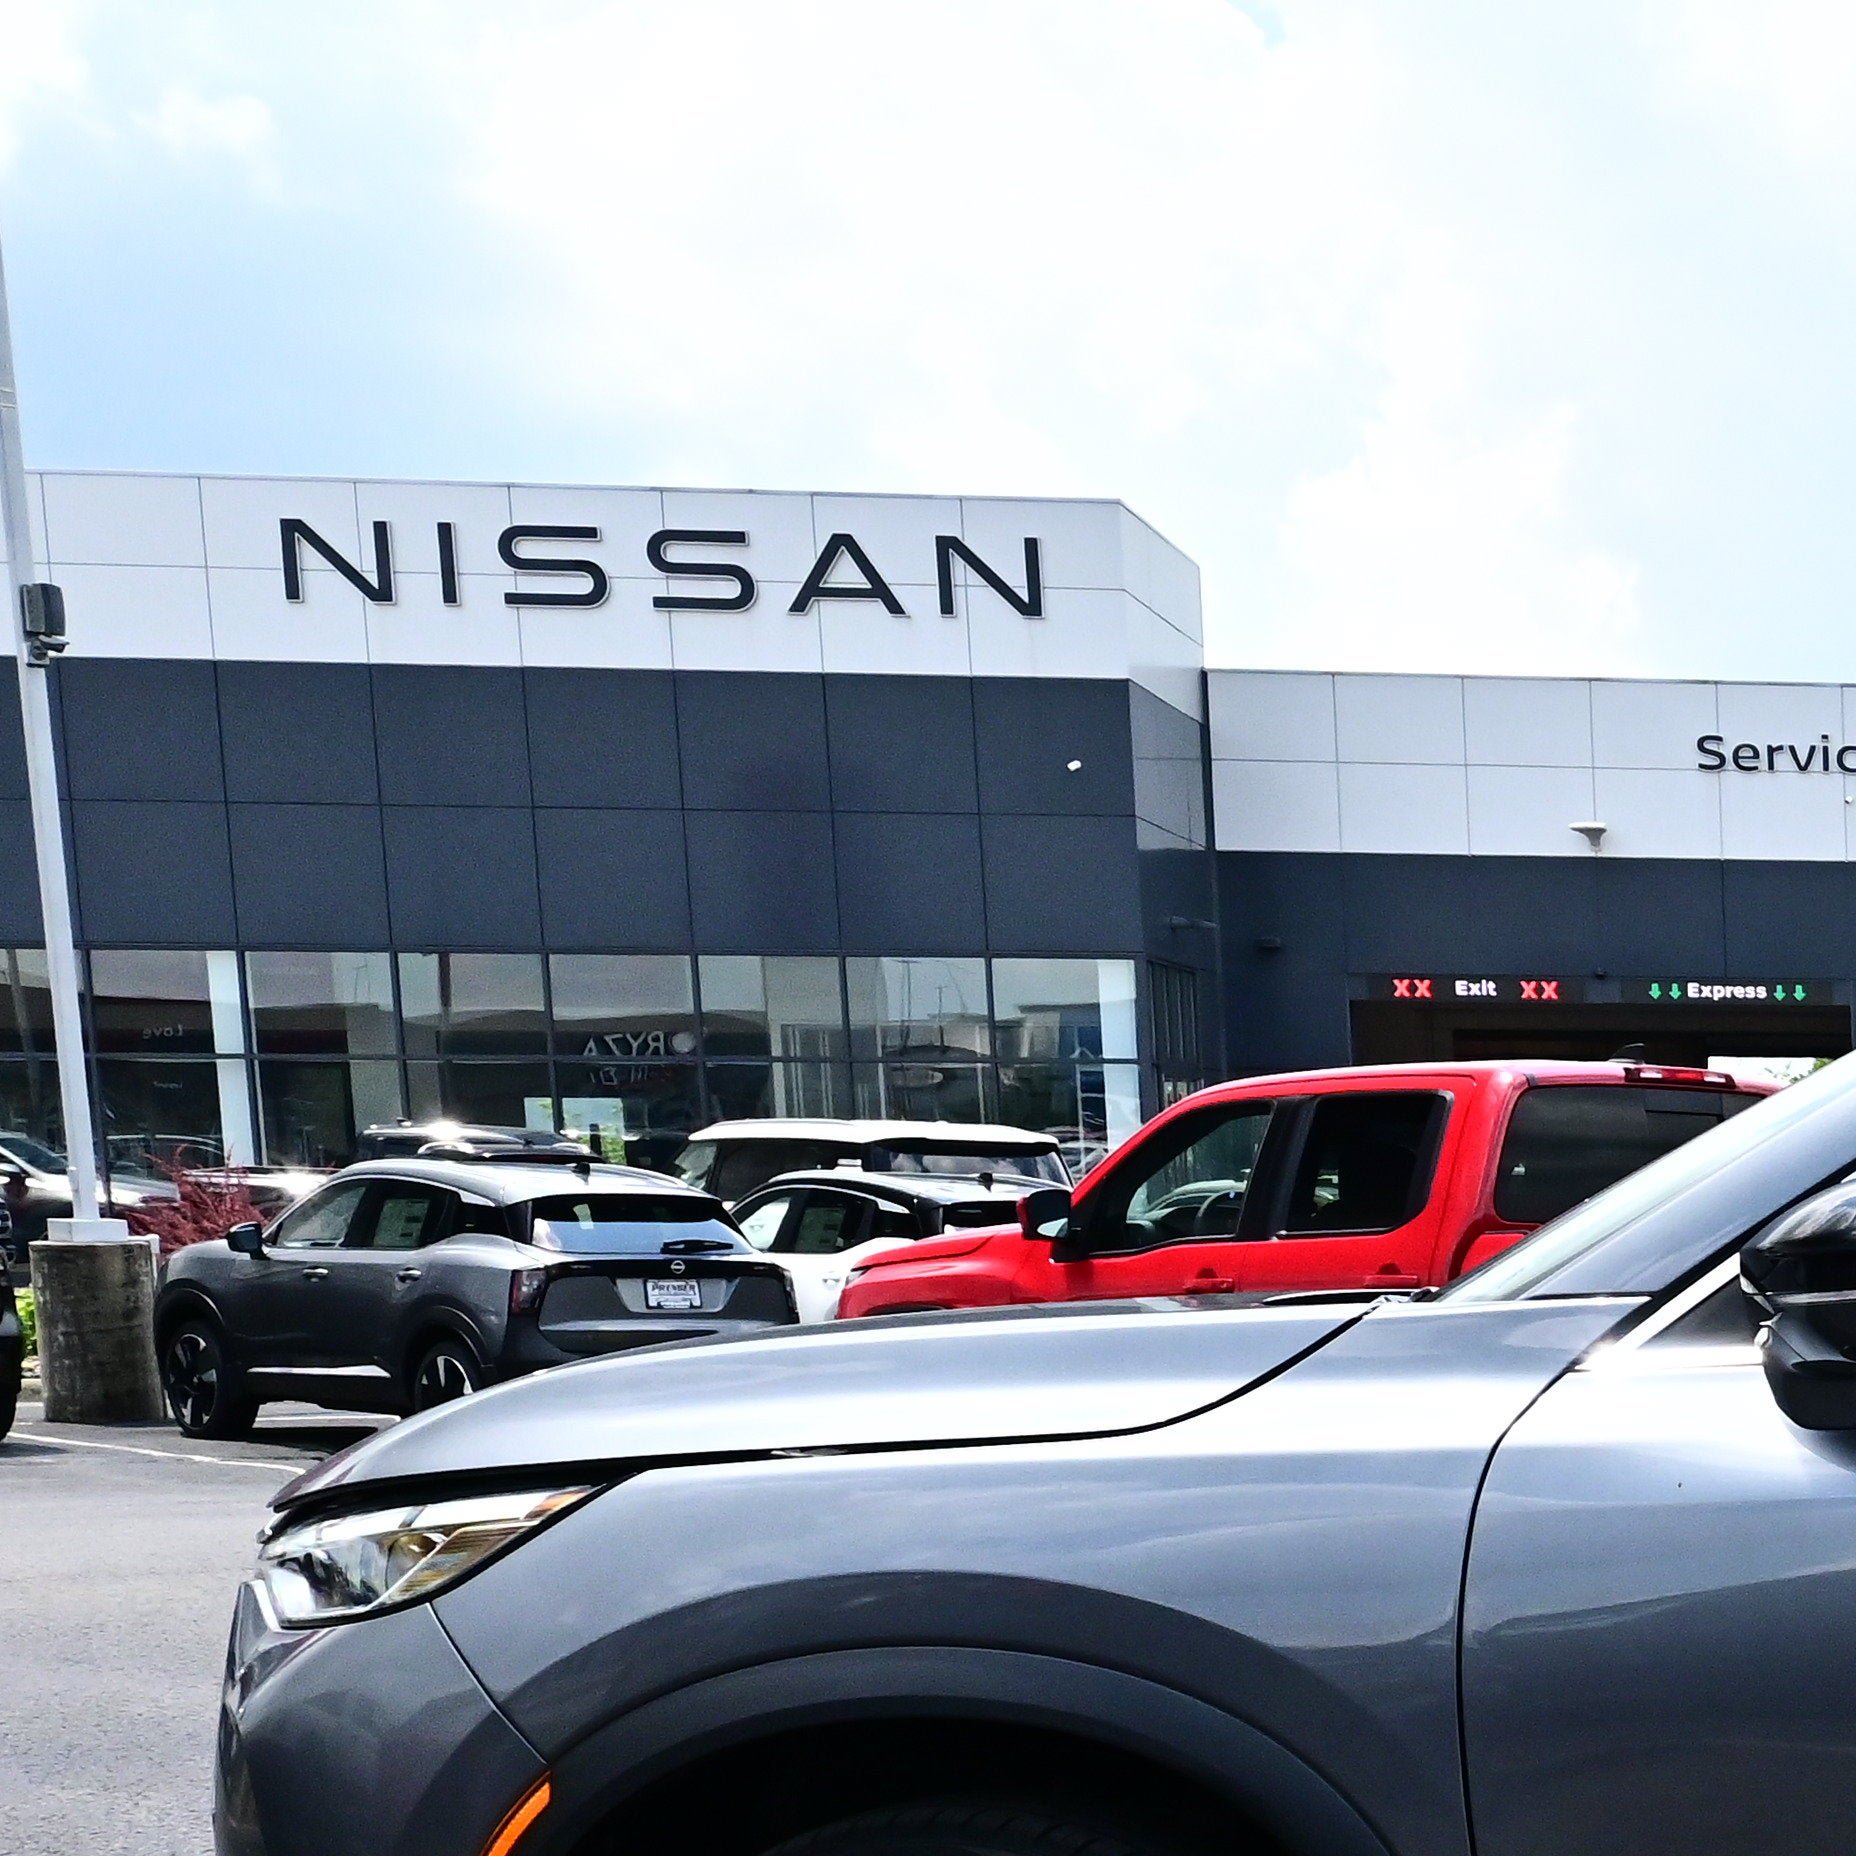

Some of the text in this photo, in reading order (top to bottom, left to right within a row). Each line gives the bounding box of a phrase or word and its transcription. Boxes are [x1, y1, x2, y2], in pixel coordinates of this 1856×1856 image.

[280, 518, 1043, 620] NISSAN
[1454, 977, 1498, 999] Exit
[1686, 981, 1769, 1003] Express
